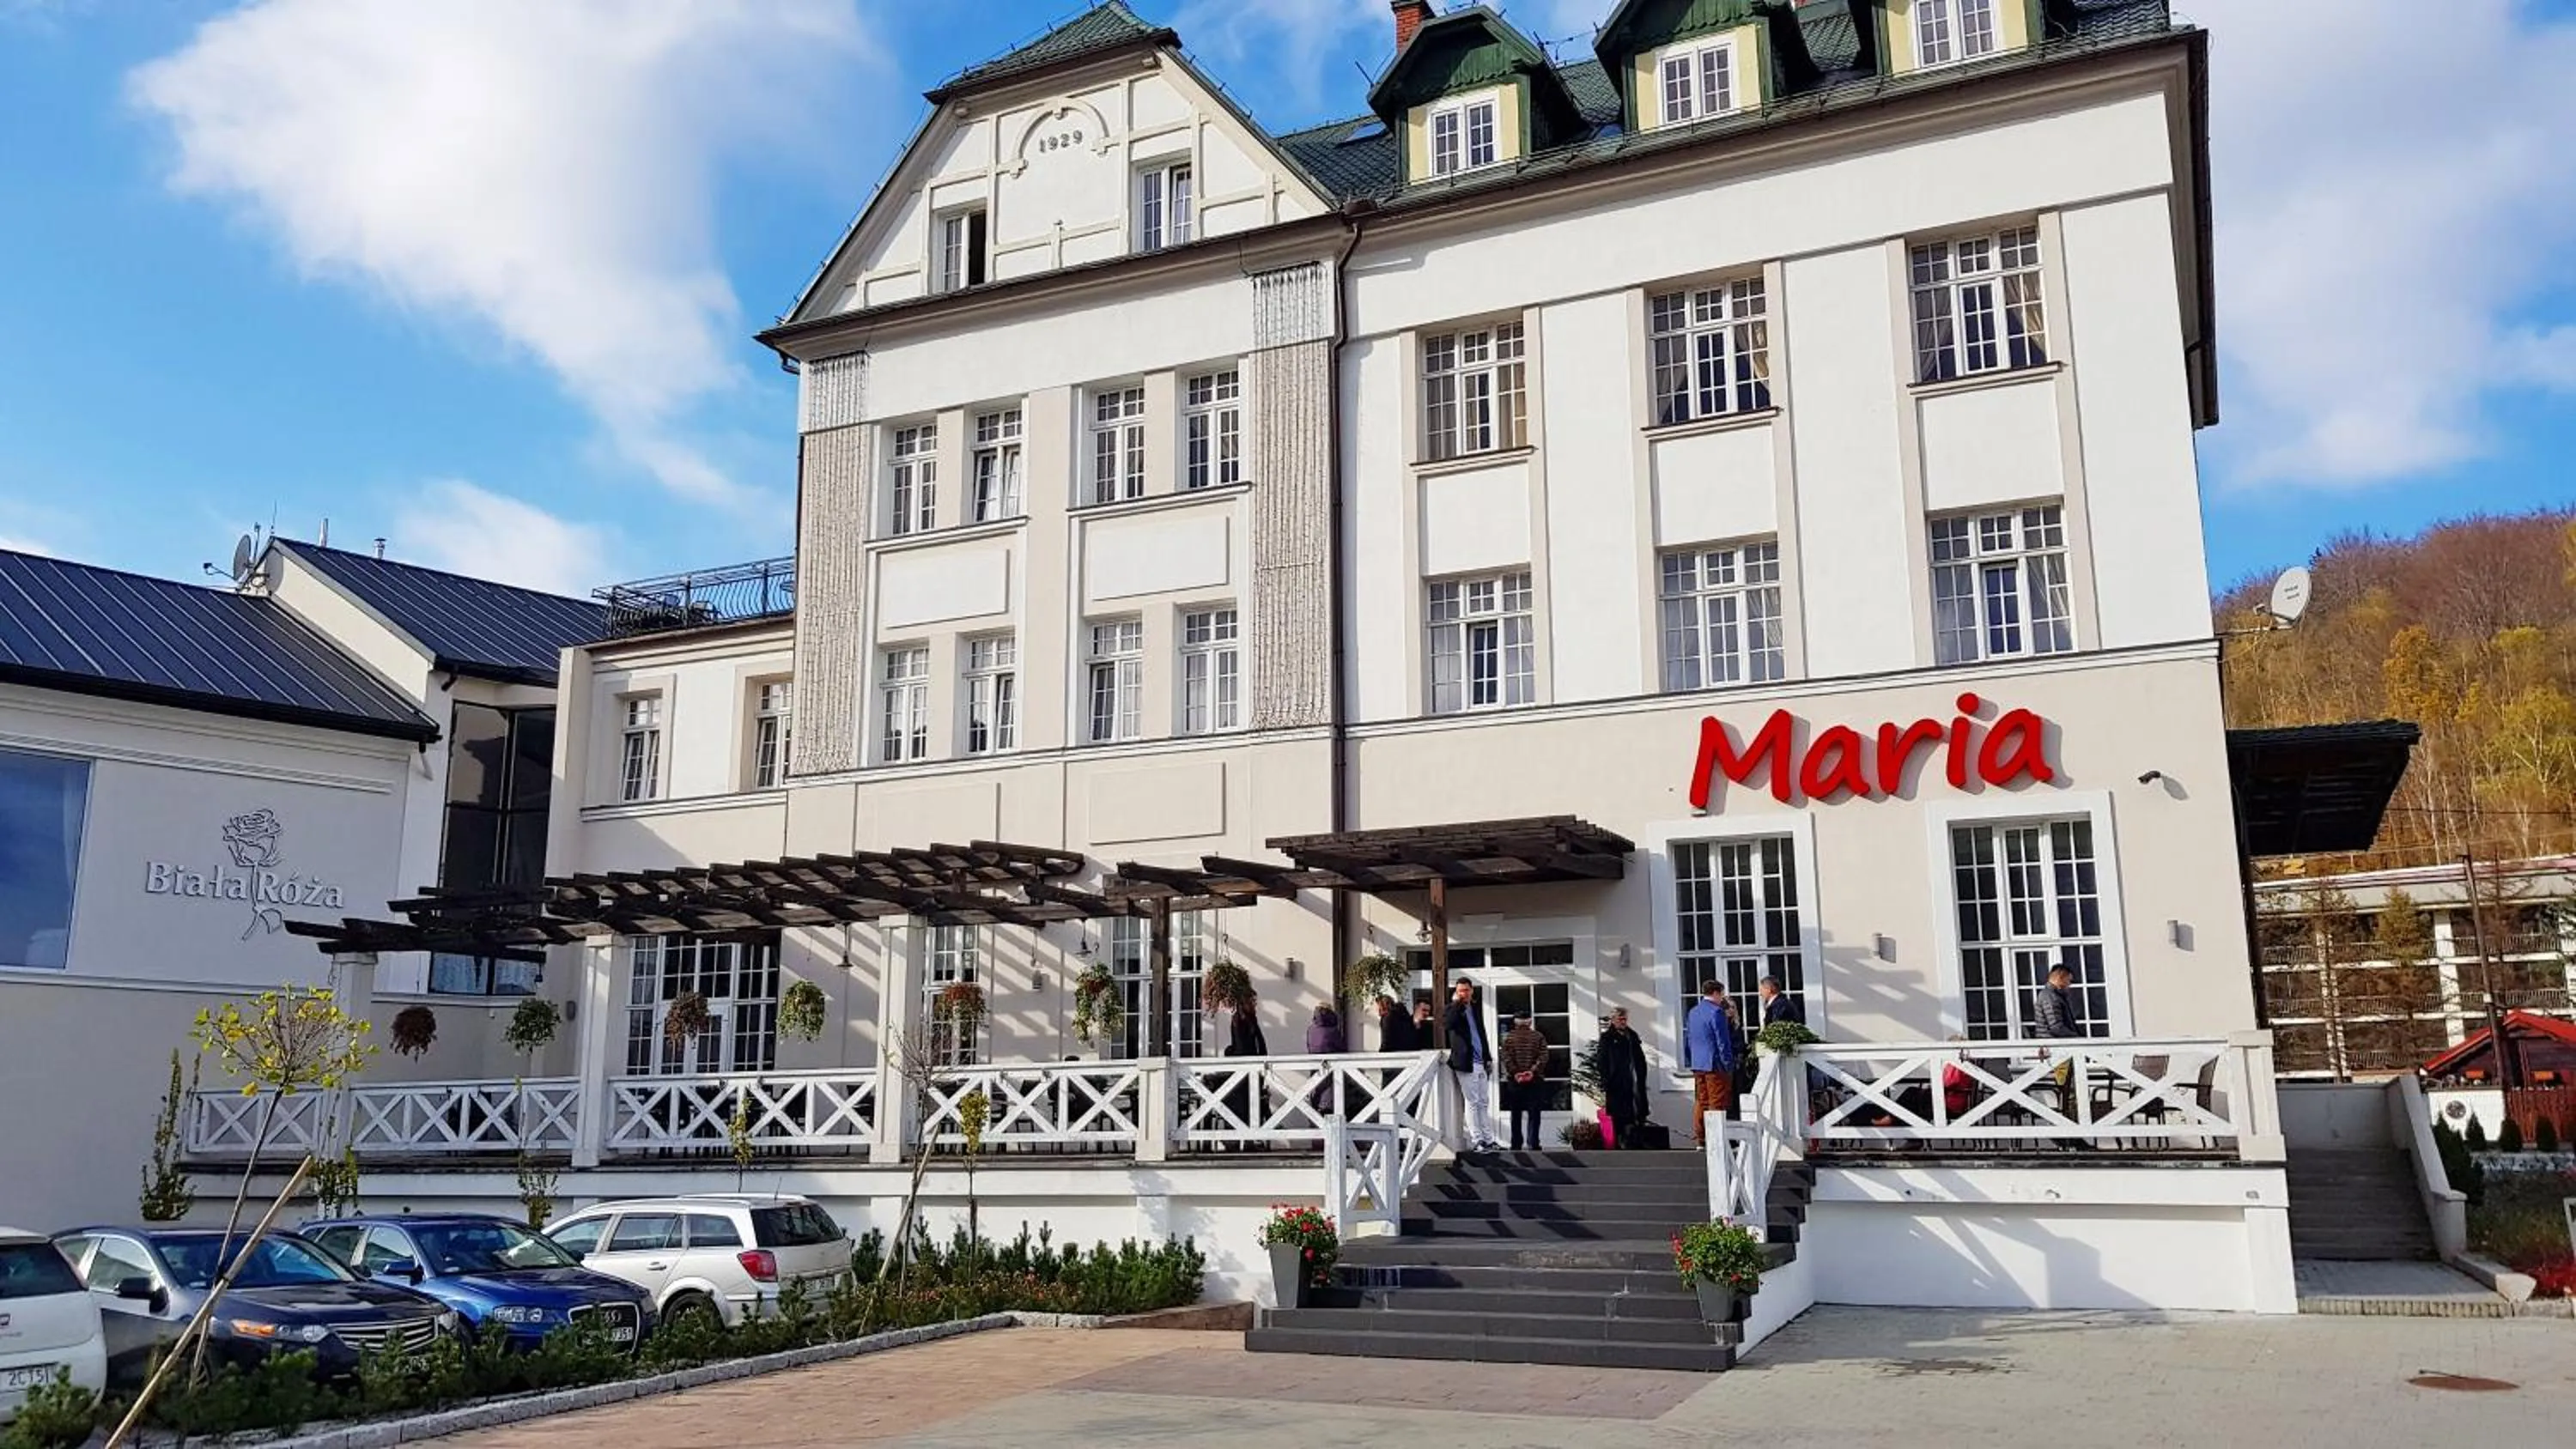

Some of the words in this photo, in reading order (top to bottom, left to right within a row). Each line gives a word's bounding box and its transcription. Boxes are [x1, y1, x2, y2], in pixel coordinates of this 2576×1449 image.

[1040, 130, 1083, 153] 1929
[1689, 692, 2053, 809] Maria
[145, 860, 248, 901] Biała
[257, 869, 344, 908] Róża
